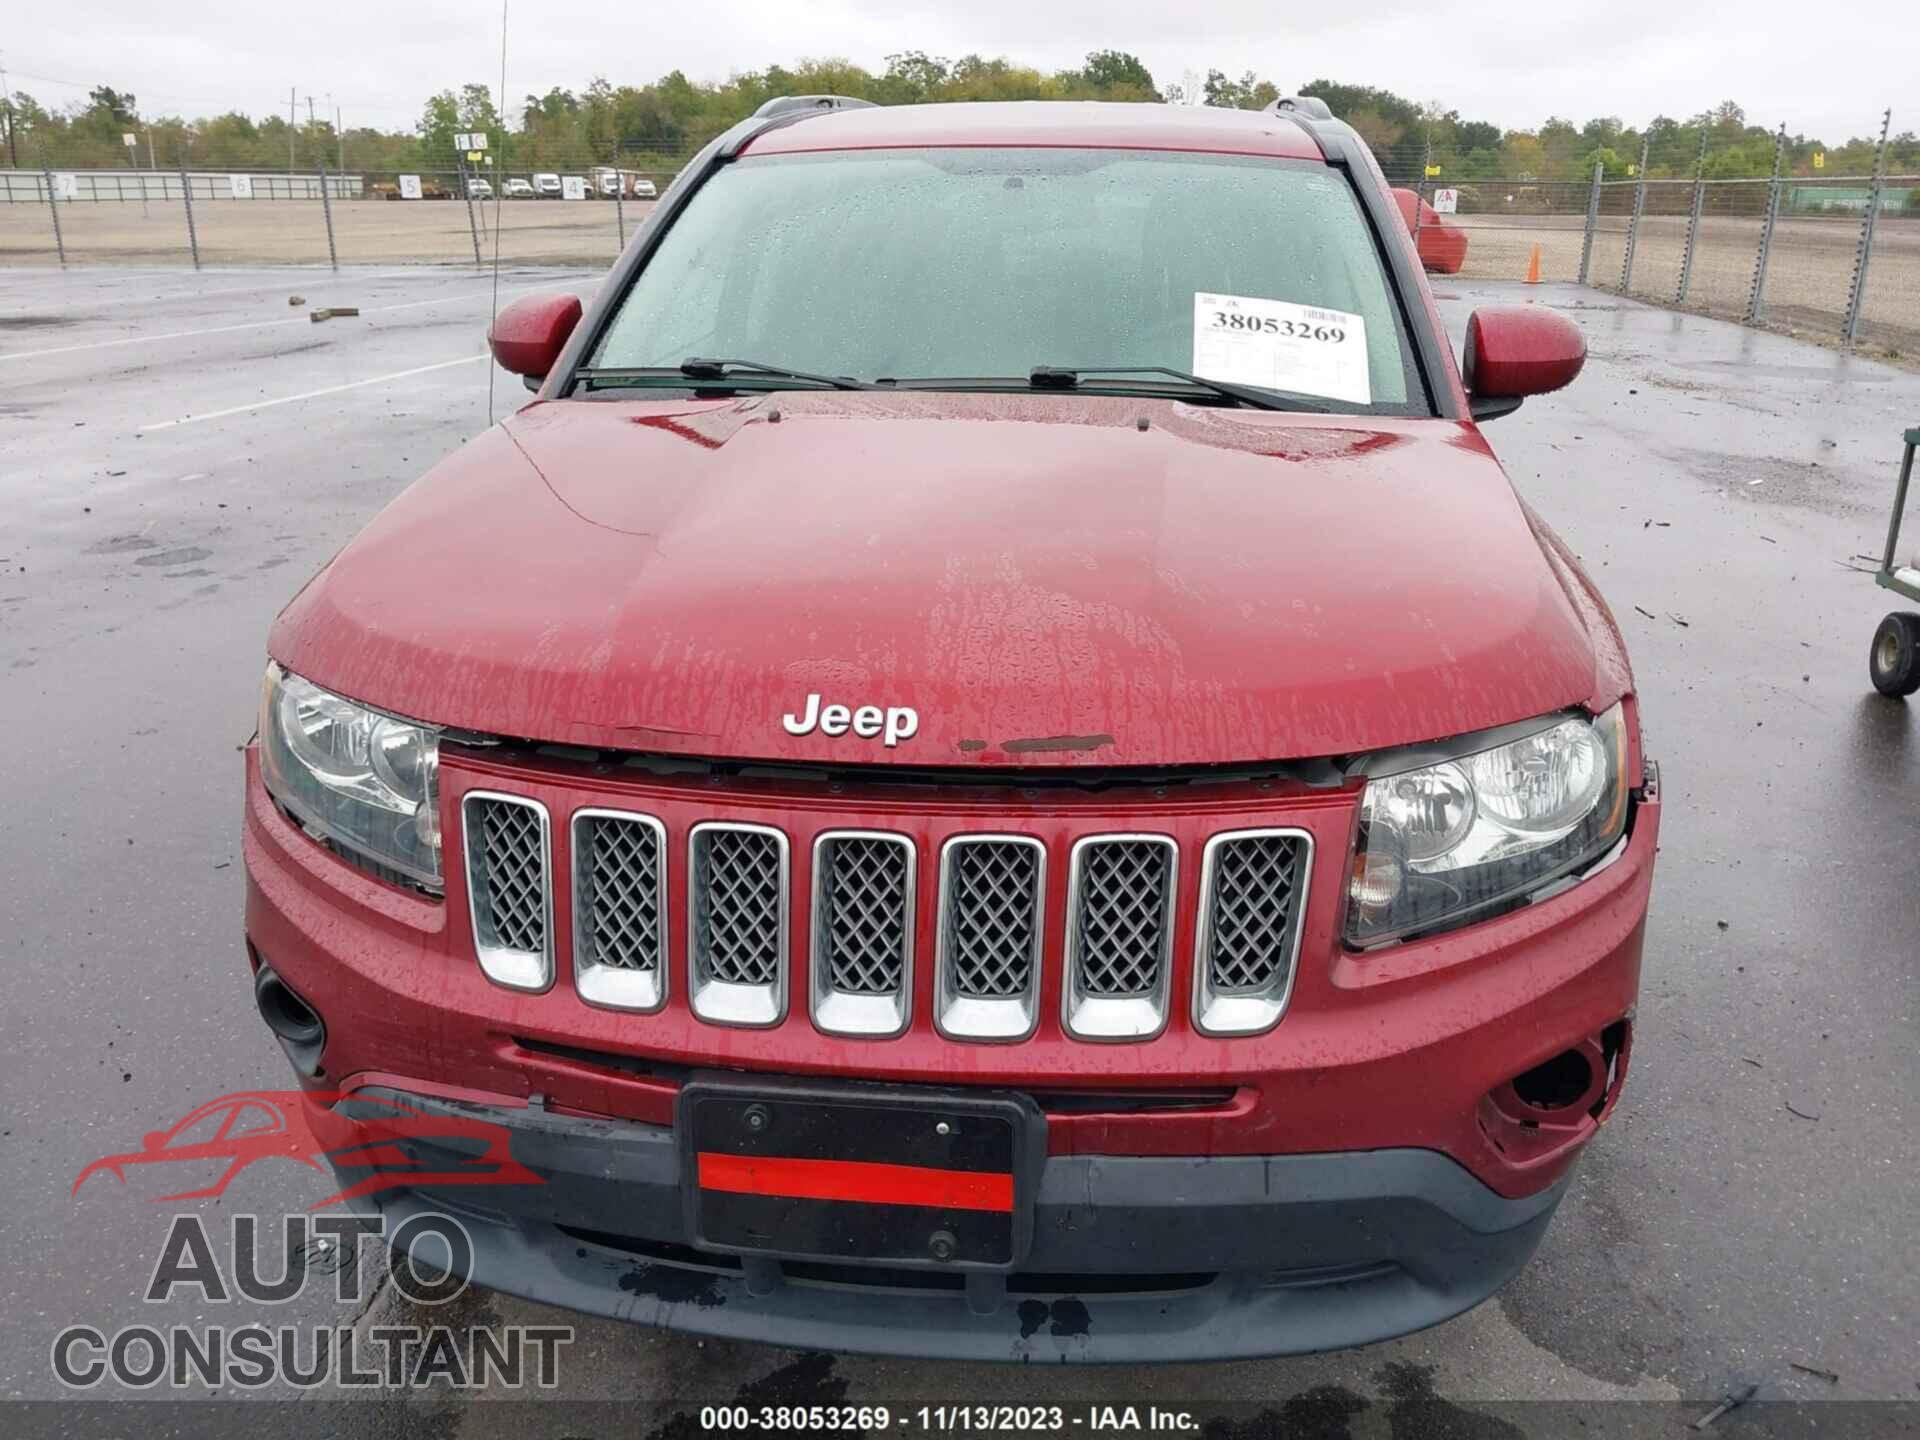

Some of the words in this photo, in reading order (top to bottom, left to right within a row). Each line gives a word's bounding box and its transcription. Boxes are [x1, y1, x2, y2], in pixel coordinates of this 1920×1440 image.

[406, 179, 416, 193] 5
[1212, 311, 1346, 344] 38053269
[783, 693, 918, 747] Jeep
